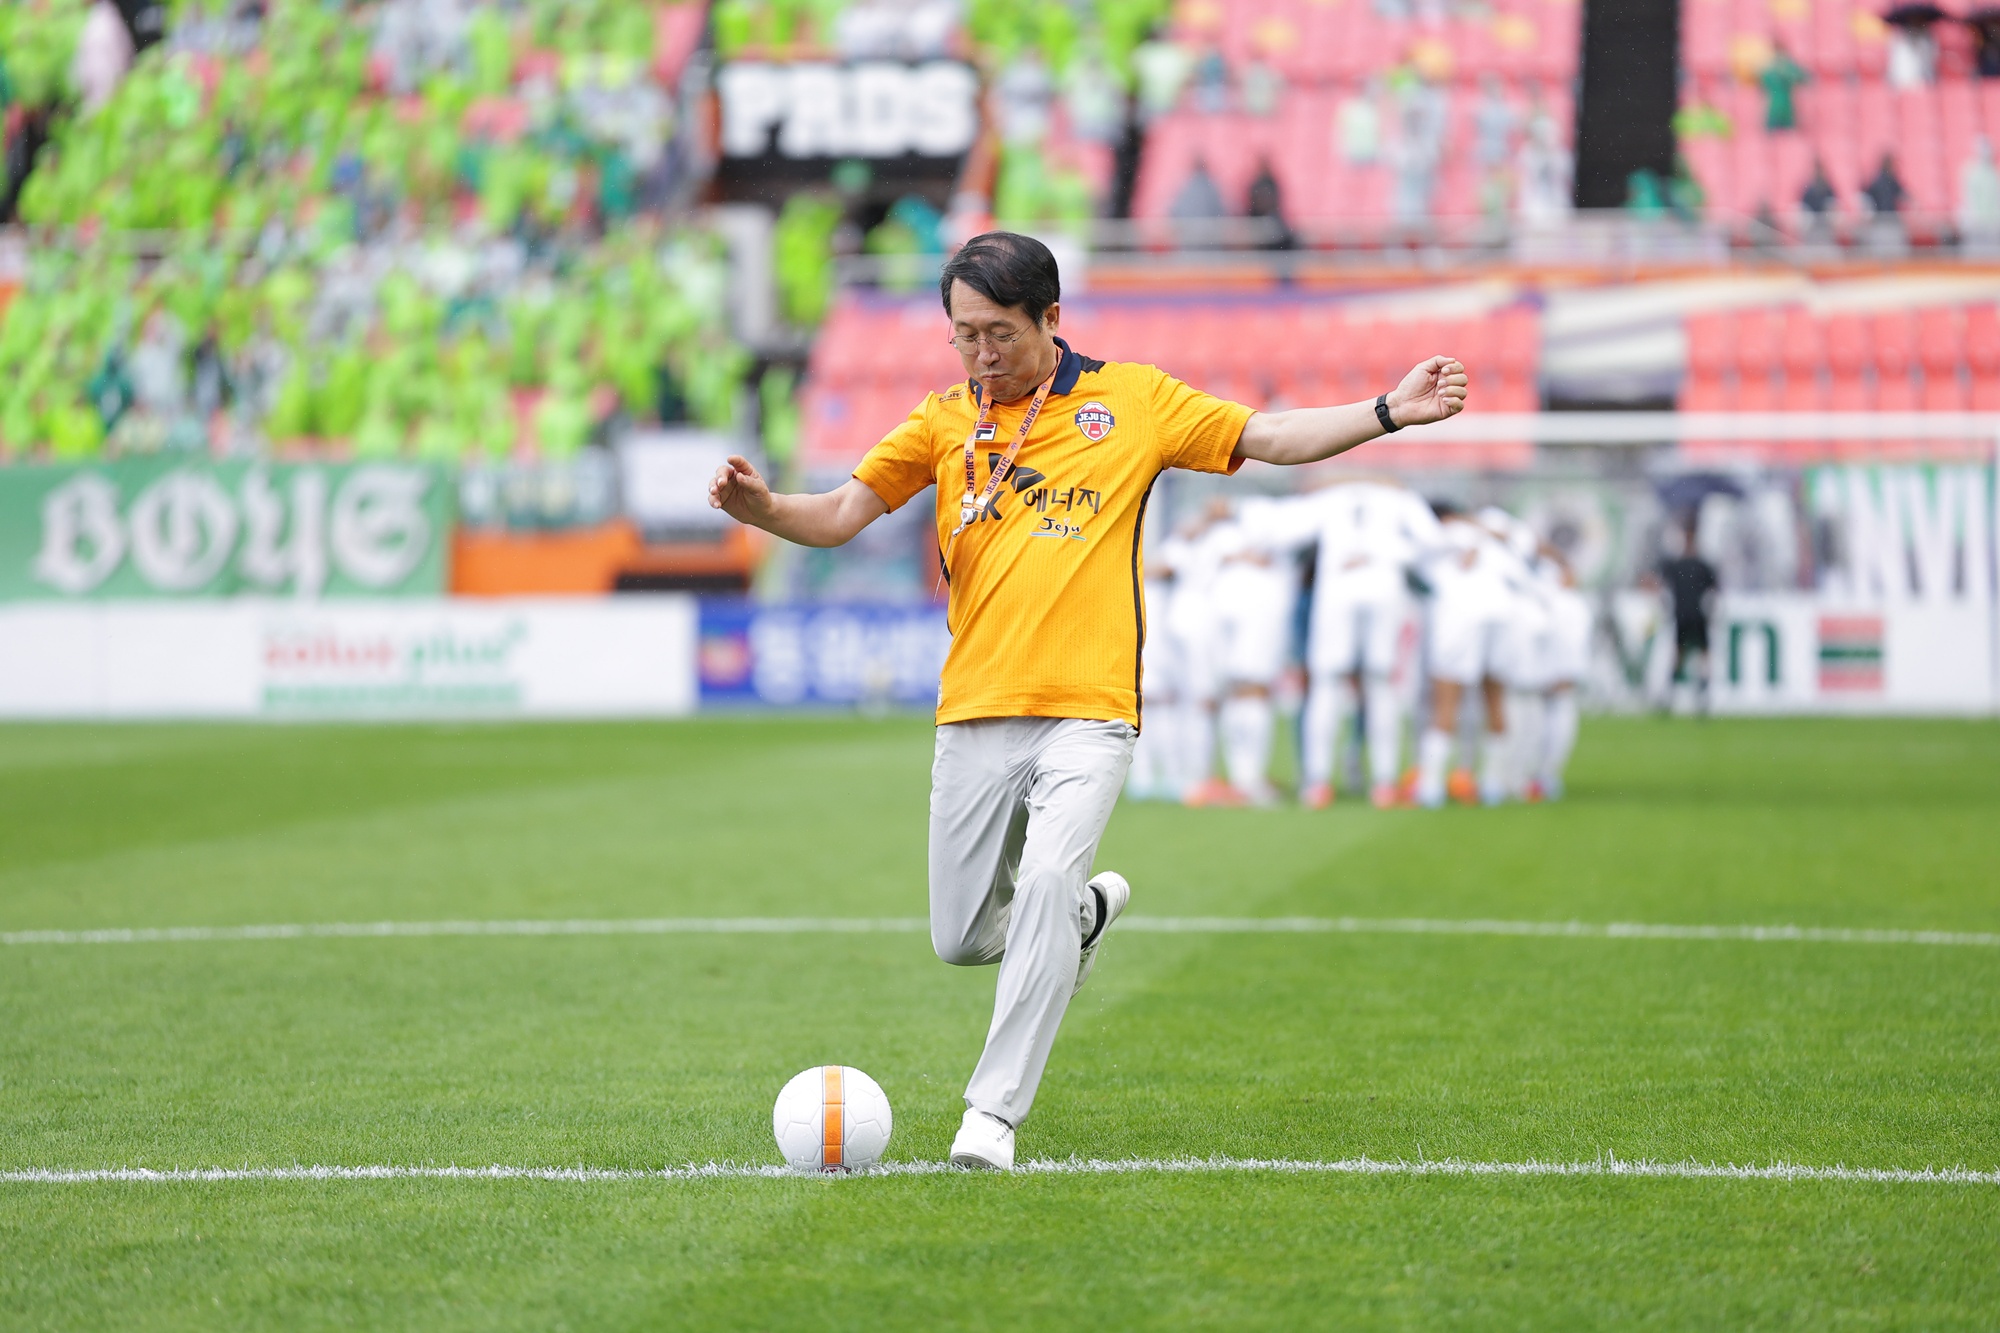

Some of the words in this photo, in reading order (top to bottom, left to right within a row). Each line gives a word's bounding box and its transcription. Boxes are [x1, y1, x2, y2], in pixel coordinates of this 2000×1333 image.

[1019, 416, 1034, 437] JEJU
[1034, 397, 1043, 409] FC
[1078, 412, 1100, 422] JEJU
[1099, 413, 1111, 424] SK
[965, 449, 974, 470] JEJU
[966, 470, 975, 481] SK
[985, 475, 1000, 495] JEJU
[1000, 456, 1011, 468] FC
[967, 482, 975, 492] FC
[1023, 487, 1101, 515] 에너지
[1039, 516, 1080, 538] Jeju
